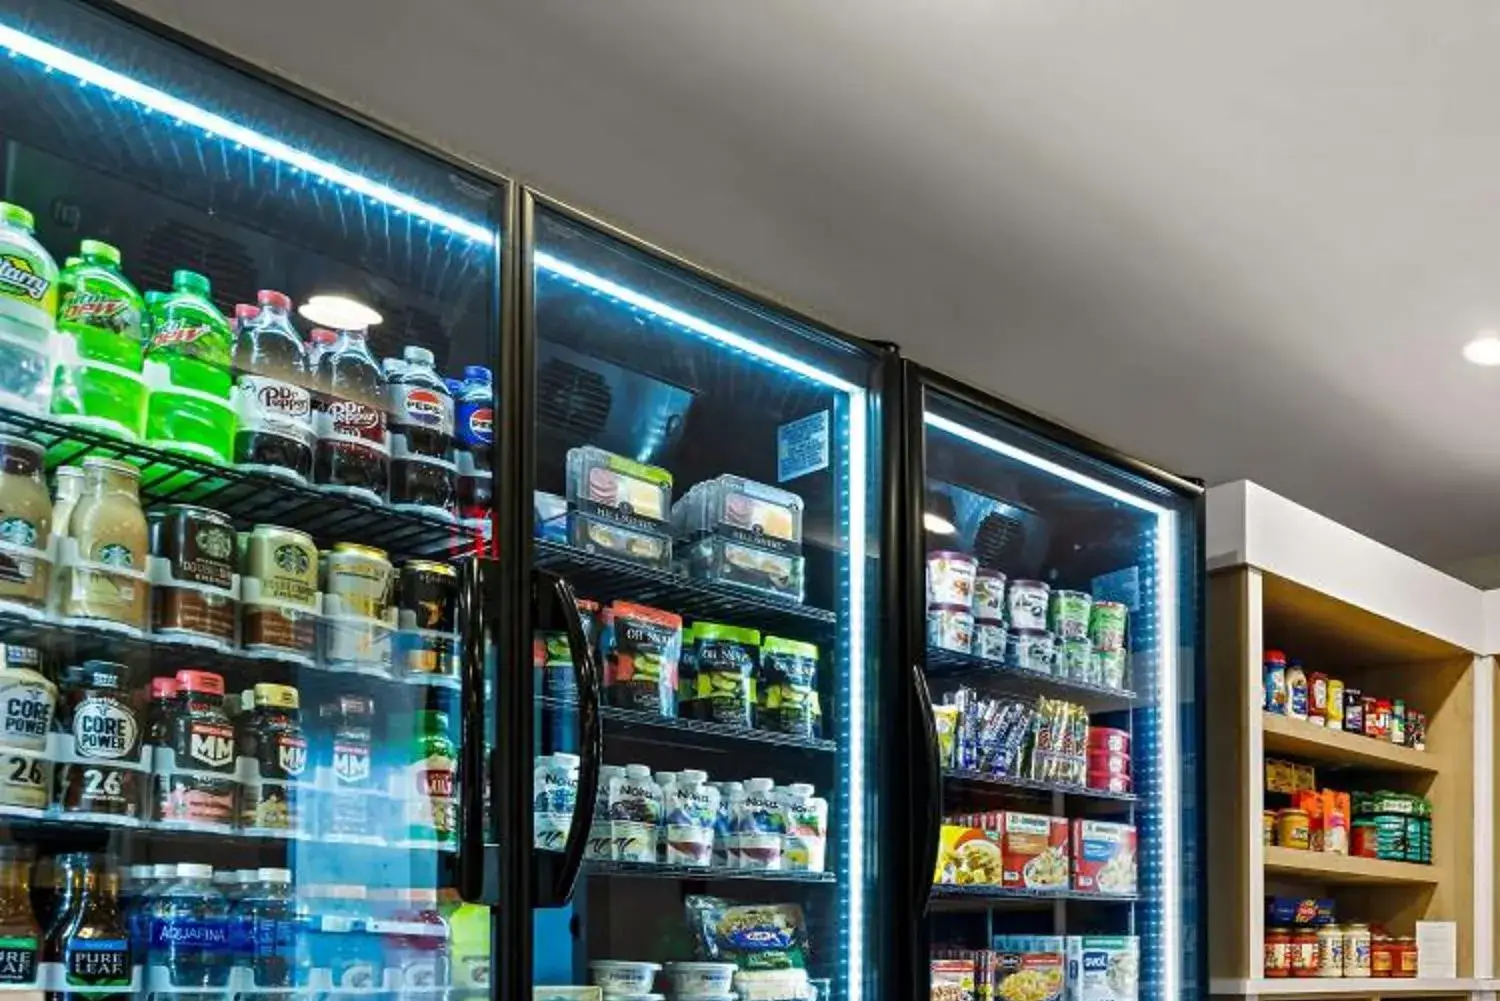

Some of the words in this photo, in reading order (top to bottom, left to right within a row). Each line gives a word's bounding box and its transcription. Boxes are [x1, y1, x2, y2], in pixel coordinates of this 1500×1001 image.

[7, 697, 51, 719] CORE
[82, 715, 127, 737] CORE
[81, 733, 126, 750] POWER
[8, 756, 42, 785] 26
[83, 769, 121, 795] 26
[158, 924, 226, 943] AQUAFINA
[74, 951, 123, 964] PURE
[74, 963, 124, 975] LEAF
